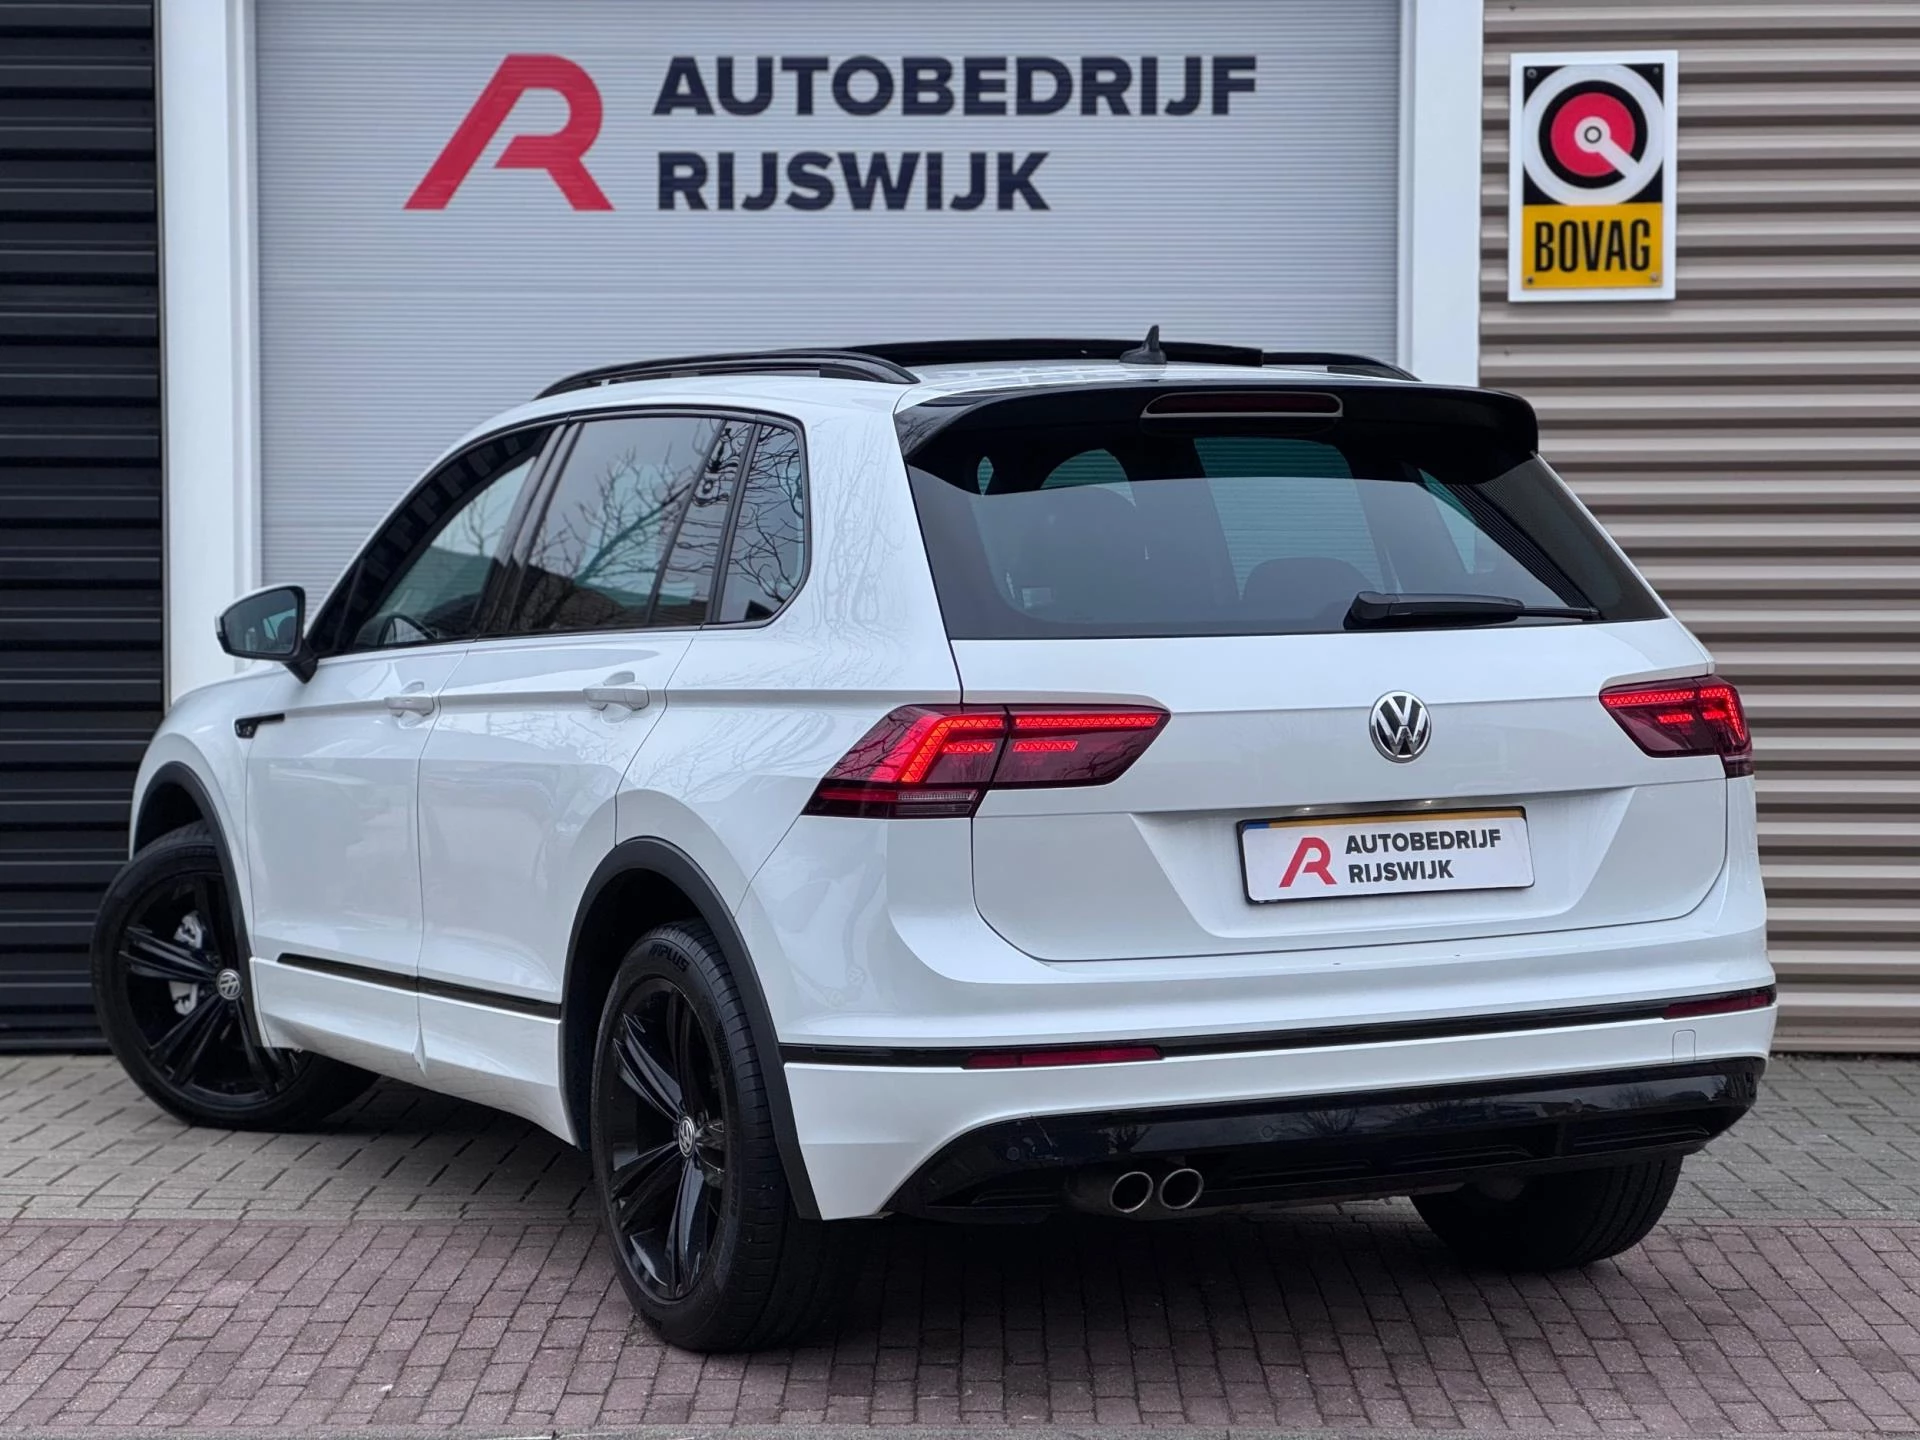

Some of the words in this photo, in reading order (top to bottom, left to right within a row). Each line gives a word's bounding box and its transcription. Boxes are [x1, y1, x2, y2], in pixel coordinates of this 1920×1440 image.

[653, 55, 1257, 117] AUTOBEDRIJF
[658, 151, 1050, 211] RIJSWIJK
[1534, 218, 1651, 273] BOVAG
[1345, 828, 1501, 855] AUTOBEDRIJF
[1348, 859, 1454, 883] RIJSWIJK
